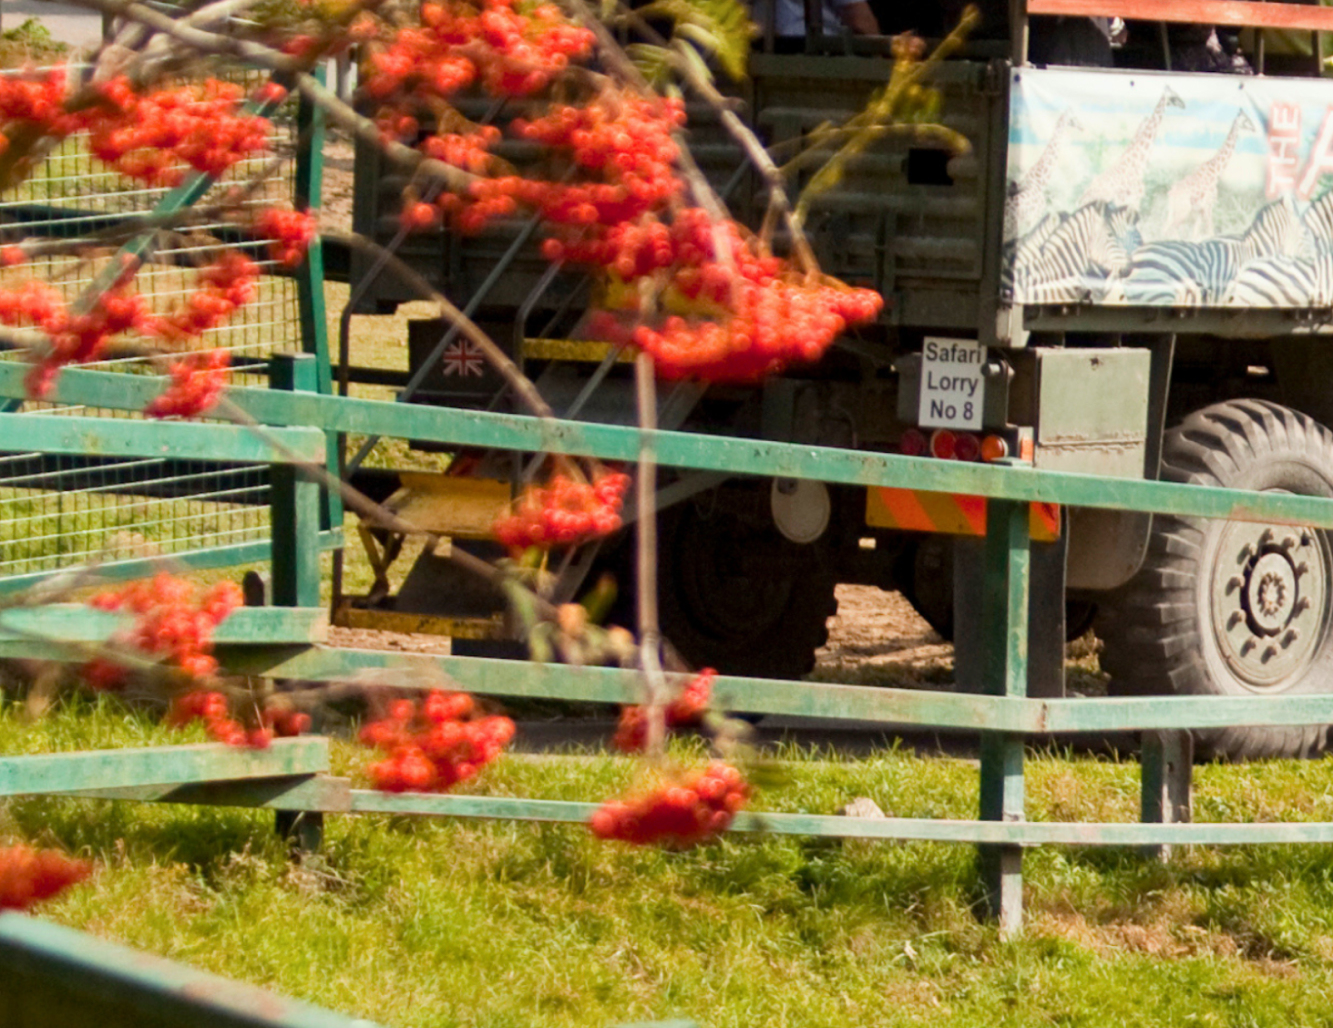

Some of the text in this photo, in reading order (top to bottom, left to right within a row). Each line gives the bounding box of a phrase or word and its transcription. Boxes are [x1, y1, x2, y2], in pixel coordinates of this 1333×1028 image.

[1267, 103, 1300, 196] THE
[925, 342, 982, 364] Safari
[927, 371, 978, 397] Lorry
[930, 399, 974, 421] No 8
